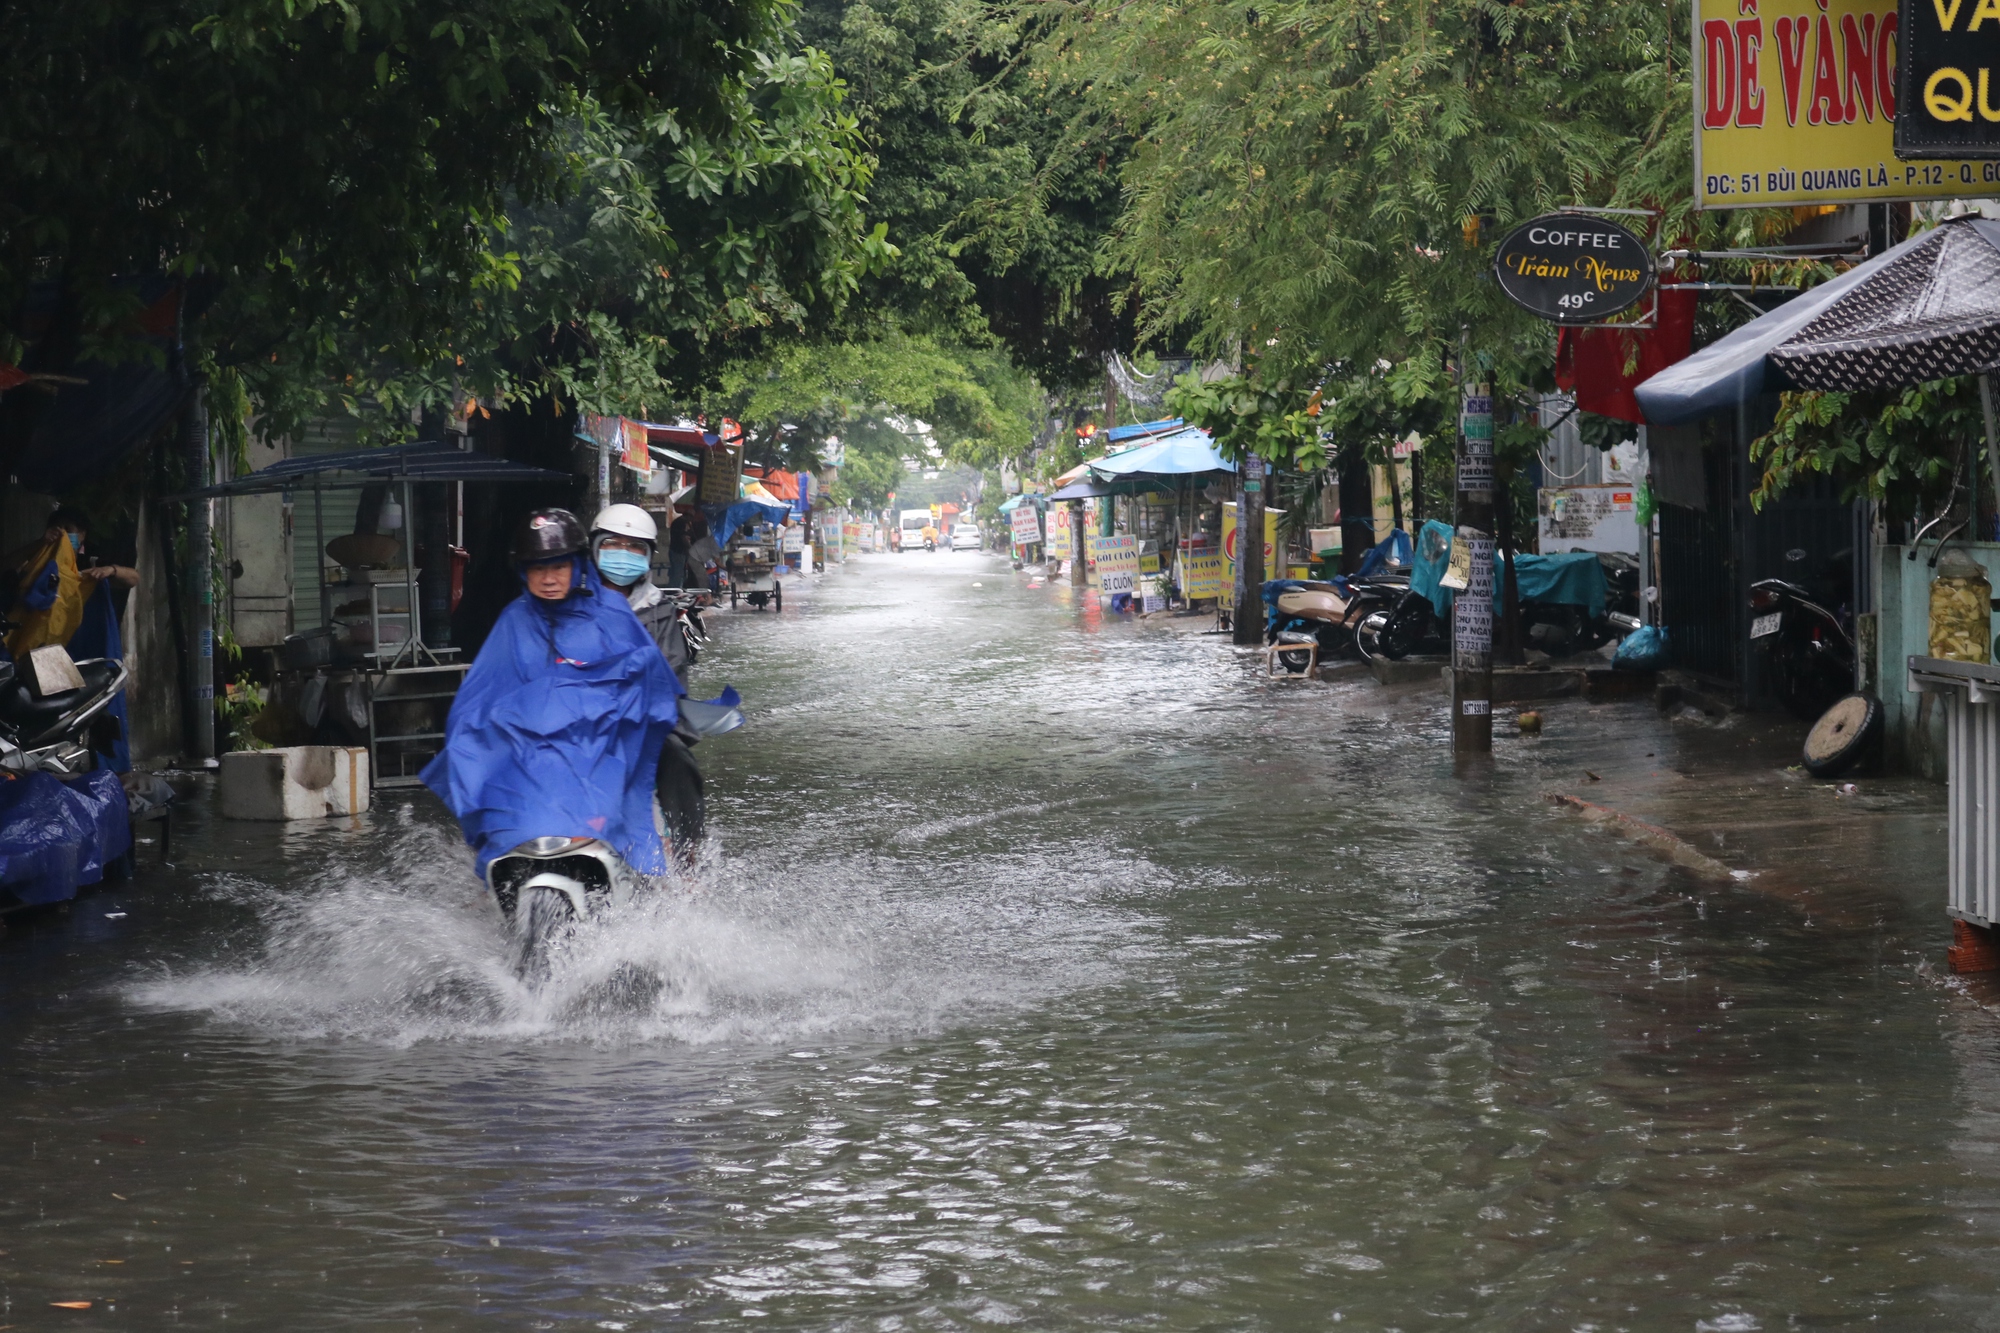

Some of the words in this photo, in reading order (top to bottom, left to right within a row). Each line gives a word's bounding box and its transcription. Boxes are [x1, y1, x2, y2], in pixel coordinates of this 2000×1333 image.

[1706, 175, 1735, 195] ĐC:
[1741, 174, 1760, 194] 51
[1767, 167, 1796, 193] BÙI
[1802, 168, 1861, 191] QUANG
[1867, 163, 1888, 188] LÀ
[1906, 165, 1942, 185] P.12
[1960, 163, 1976, 184] Q.
[1528, 227, 1622, 249] COFFEE
[1505, 252, 1570, 278] Trâm
[1574, 255, 1641, 293] News
